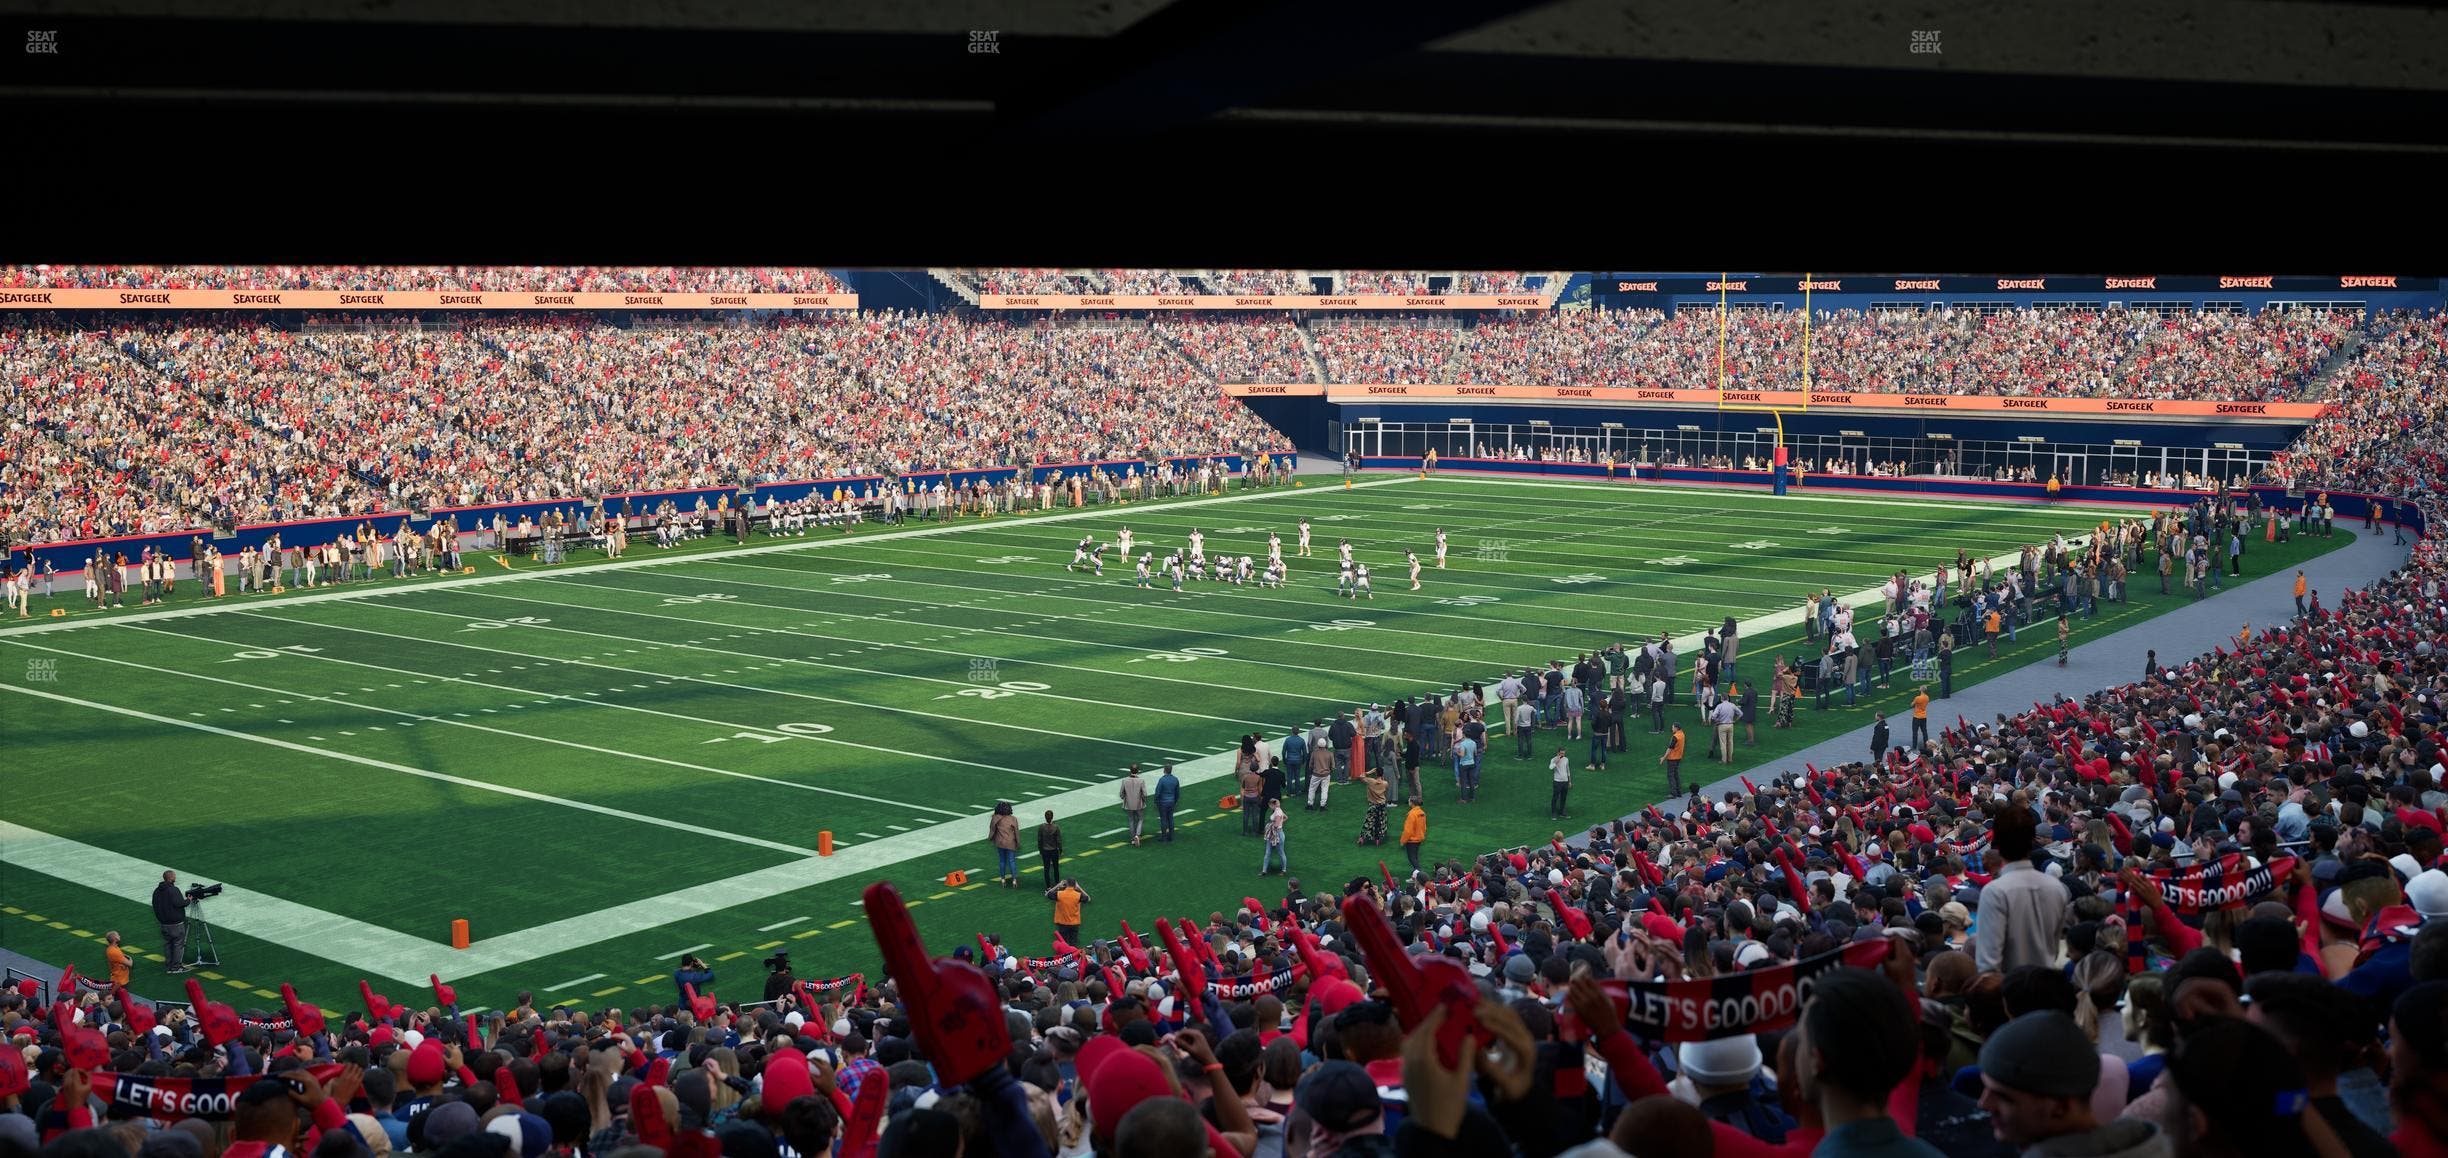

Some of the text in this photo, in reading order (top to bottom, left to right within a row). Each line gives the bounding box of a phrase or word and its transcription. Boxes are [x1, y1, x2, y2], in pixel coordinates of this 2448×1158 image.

[1619, 282, 1657, 291] SEATGEEK
[1895, 280, 1940, 290] SEATGEEK
[1998, 279, 2044, 289] SEATGEEK
[2106, 278, 2155, 289] SEATGEEK
[2220, 277, 2272, 288] SEATGEEK
[2341, 276, 2397, 287] SEATGEEK
[120, 294, 170, 304] SEATGEEK
[234, 294, 281, 304] SEATGEEK
[340, 295, 384, 304] SEATGEEK
[440, 295, 482, 304] SEATGEEK
[535, 296, 574, 304] SEATGEEK
[625, 296, 663, 304] SEATGEEK
[711, 297, 747, 305] SEATGEEK
[794, 297, 828, 305] SEATGEEK
[1457, 387, 1495, 395] SEATGEEK
[1558, 389, 1591, 397] SEATGEEK
[1638, 391, 1674, 399] SEATGEEK
[1723, 393, 1760, 401] SEATGEEK
[1811, 395, 1851, 403] SEATGEEK
[1904, 397, 1946, 406] SEATGEEK
[2003, 399, 2047, 409] SEATGEEK
[2107, 402, 2153, 412] SEATGEEK
[2216, 402, 2265, 414] SEATGEEK
[1433, 595, 1502, 606] 50
[466, 616, 552, 629] 20
[1309, 618, 1377, 632] 40
[233, 643, 325, 660] 10
[1146, 647, 1229, 662] 30
[956, 681, 1052, 700] 20
[733, 722, 835, 744] 10
[2161, 881, 2197, 907] LET'S
[2198, 868, 2273, 907] GOOOOO!!!
[1207, 982, 1230, 997] ET'S
[1628, 985, 1698, 1030] LET'S
[115, 1078, 177, 1113] LET'S
